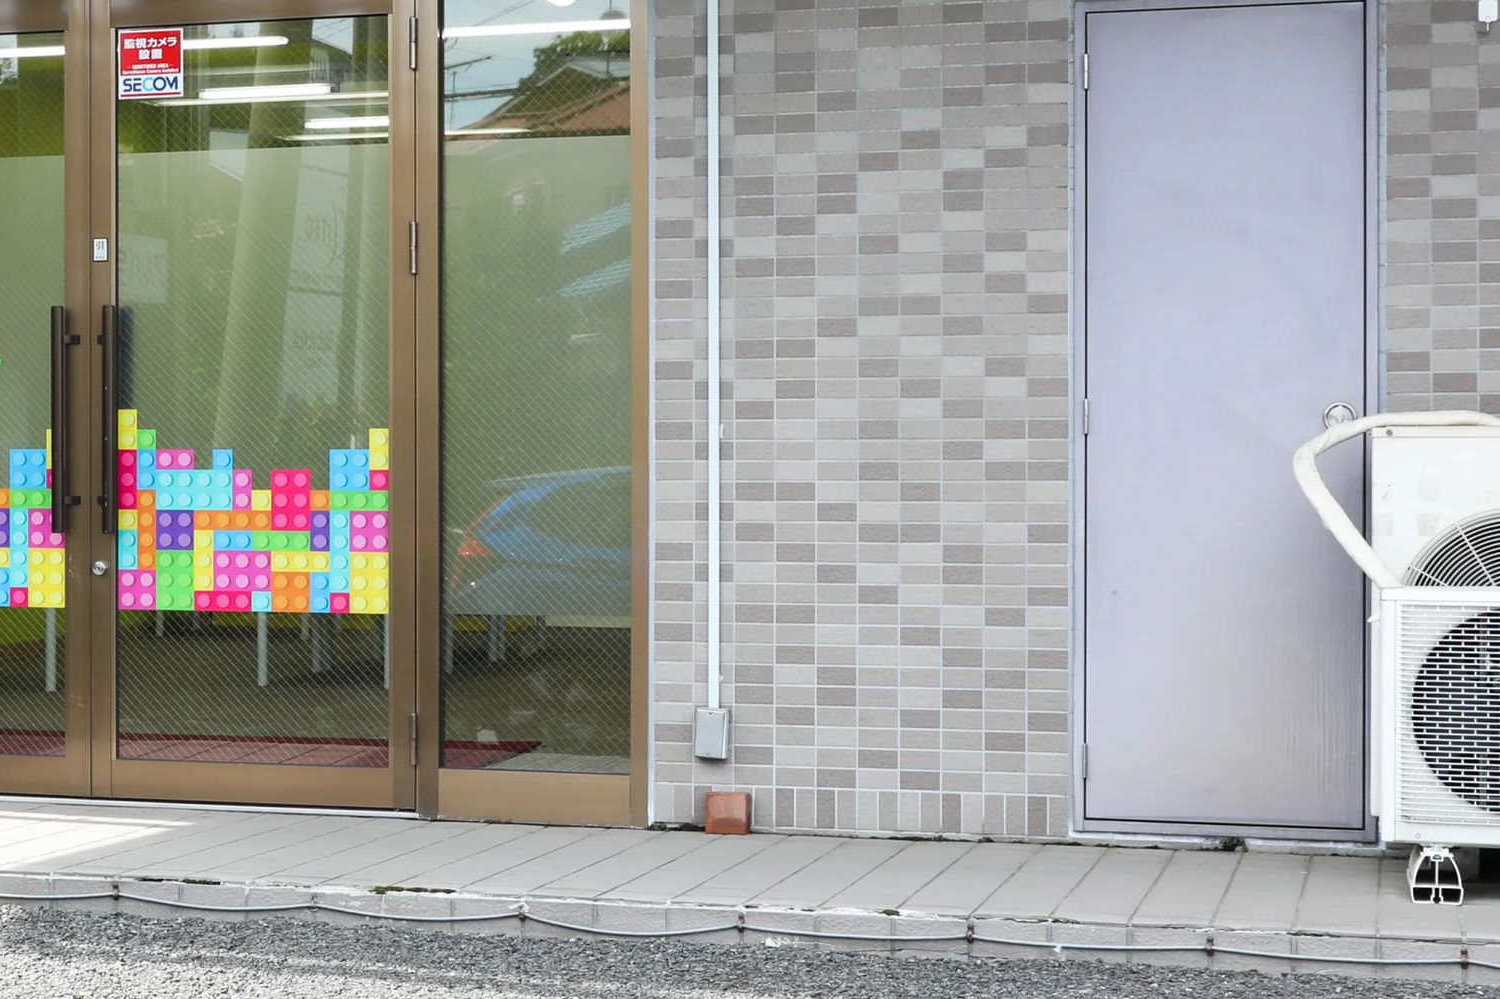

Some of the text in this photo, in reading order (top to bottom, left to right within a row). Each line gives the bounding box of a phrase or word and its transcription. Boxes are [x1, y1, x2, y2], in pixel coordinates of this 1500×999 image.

[124, 37, 177, 49] 監視カメラ
[123, 76, 178, 92] SECOM
